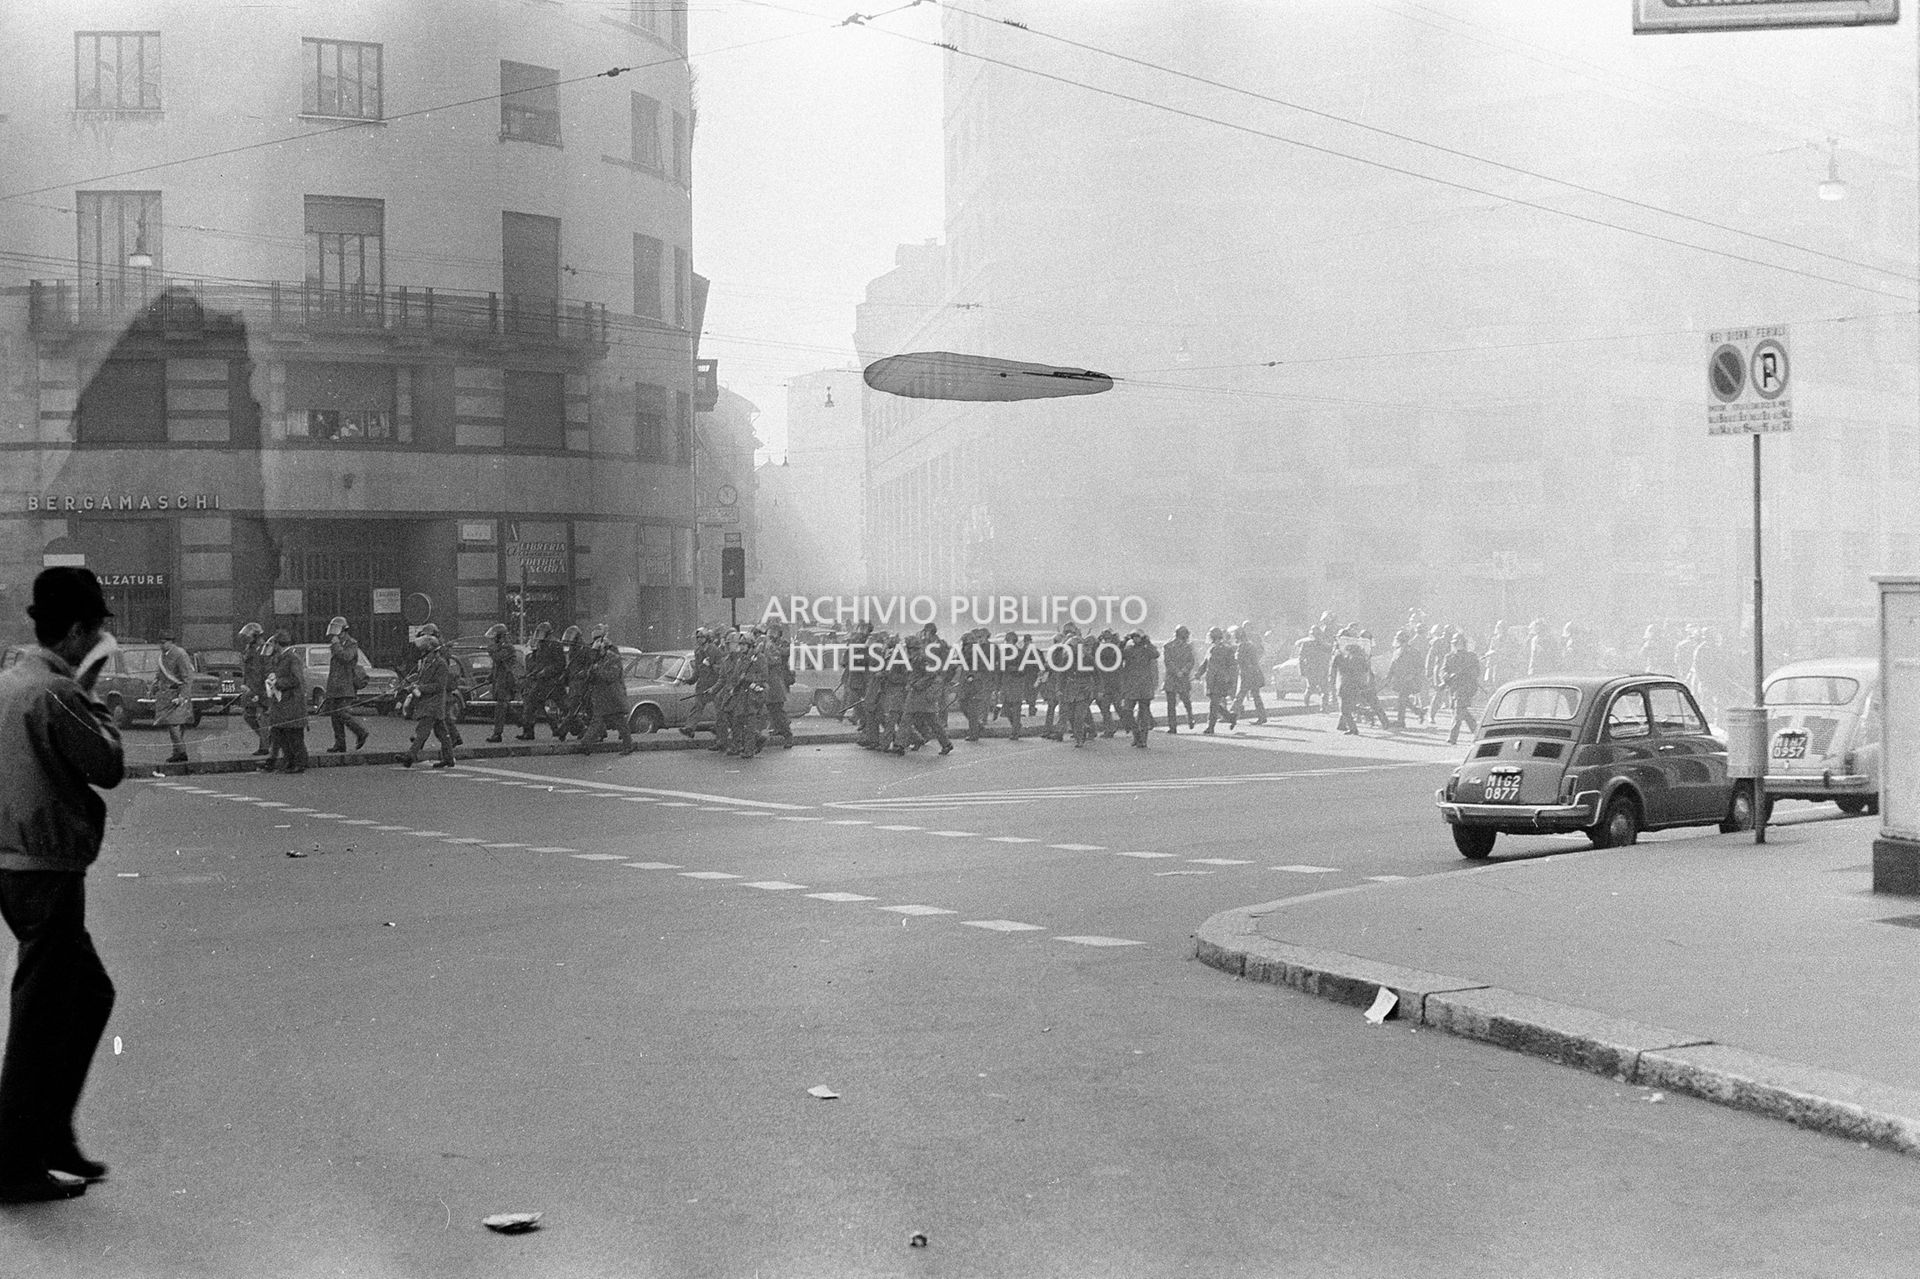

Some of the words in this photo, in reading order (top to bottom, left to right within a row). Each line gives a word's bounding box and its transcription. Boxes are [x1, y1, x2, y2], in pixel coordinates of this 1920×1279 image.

[1762, 353, 1777, 388] P
[28, 495, 220, 511] BERGAMASCHI
[96, 574, 164, 585] ALZATURE
[1773, 746, 1805, 758] 0957
[1484, 787, 1519, 800] 0877
